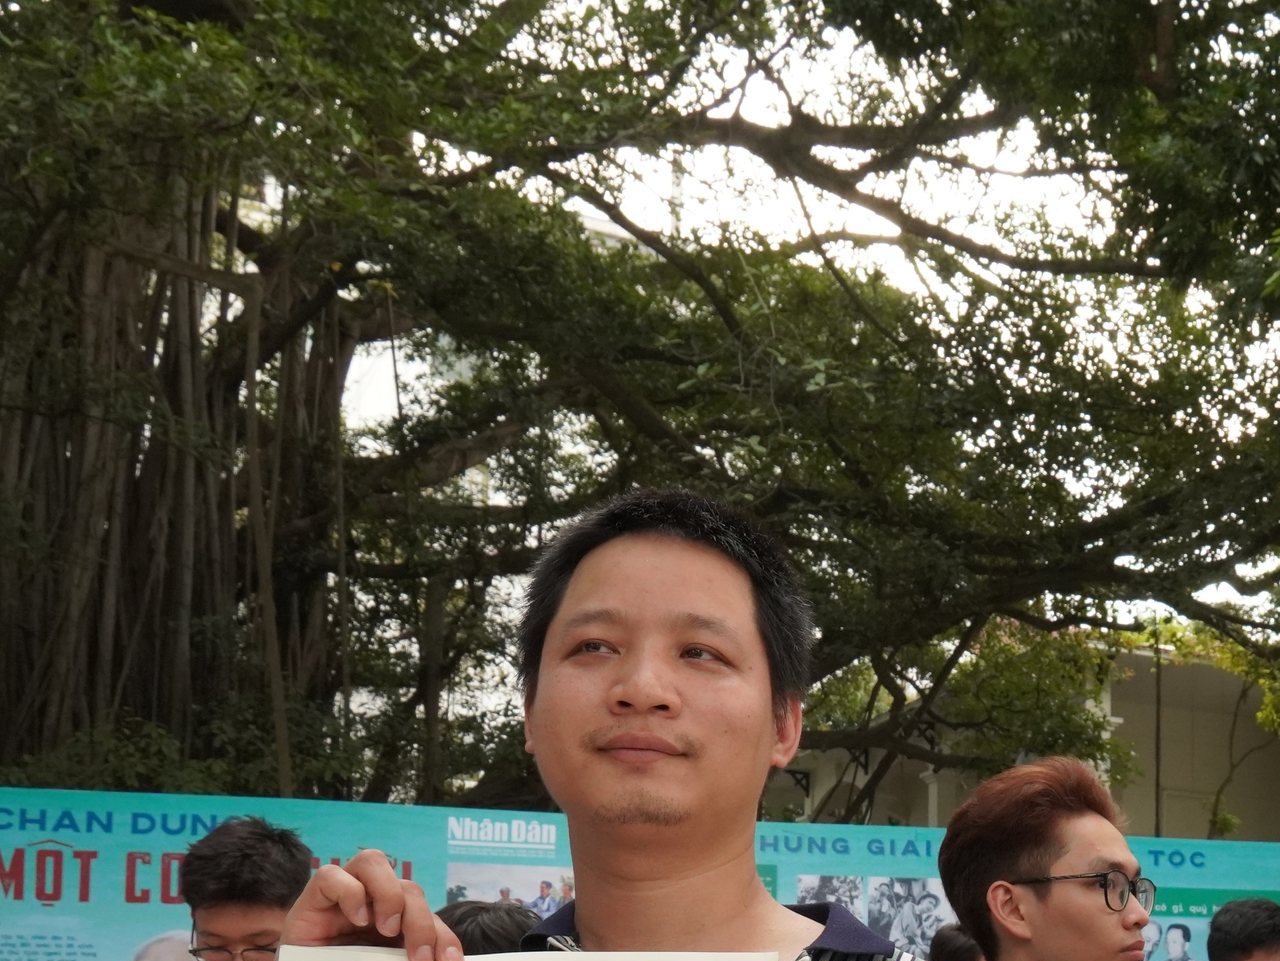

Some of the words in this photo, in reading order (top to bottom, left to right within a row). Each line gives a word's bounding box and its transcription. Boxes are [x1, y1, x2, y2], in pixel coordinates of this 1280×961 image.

[131, 812, 217, 836] DUN
[447, 816, 508, 842] Nhân
[512, 820, 556, 844] Dân
[0, 839, 97, 907] MỘT
[125, 851, 185, 904] CO
